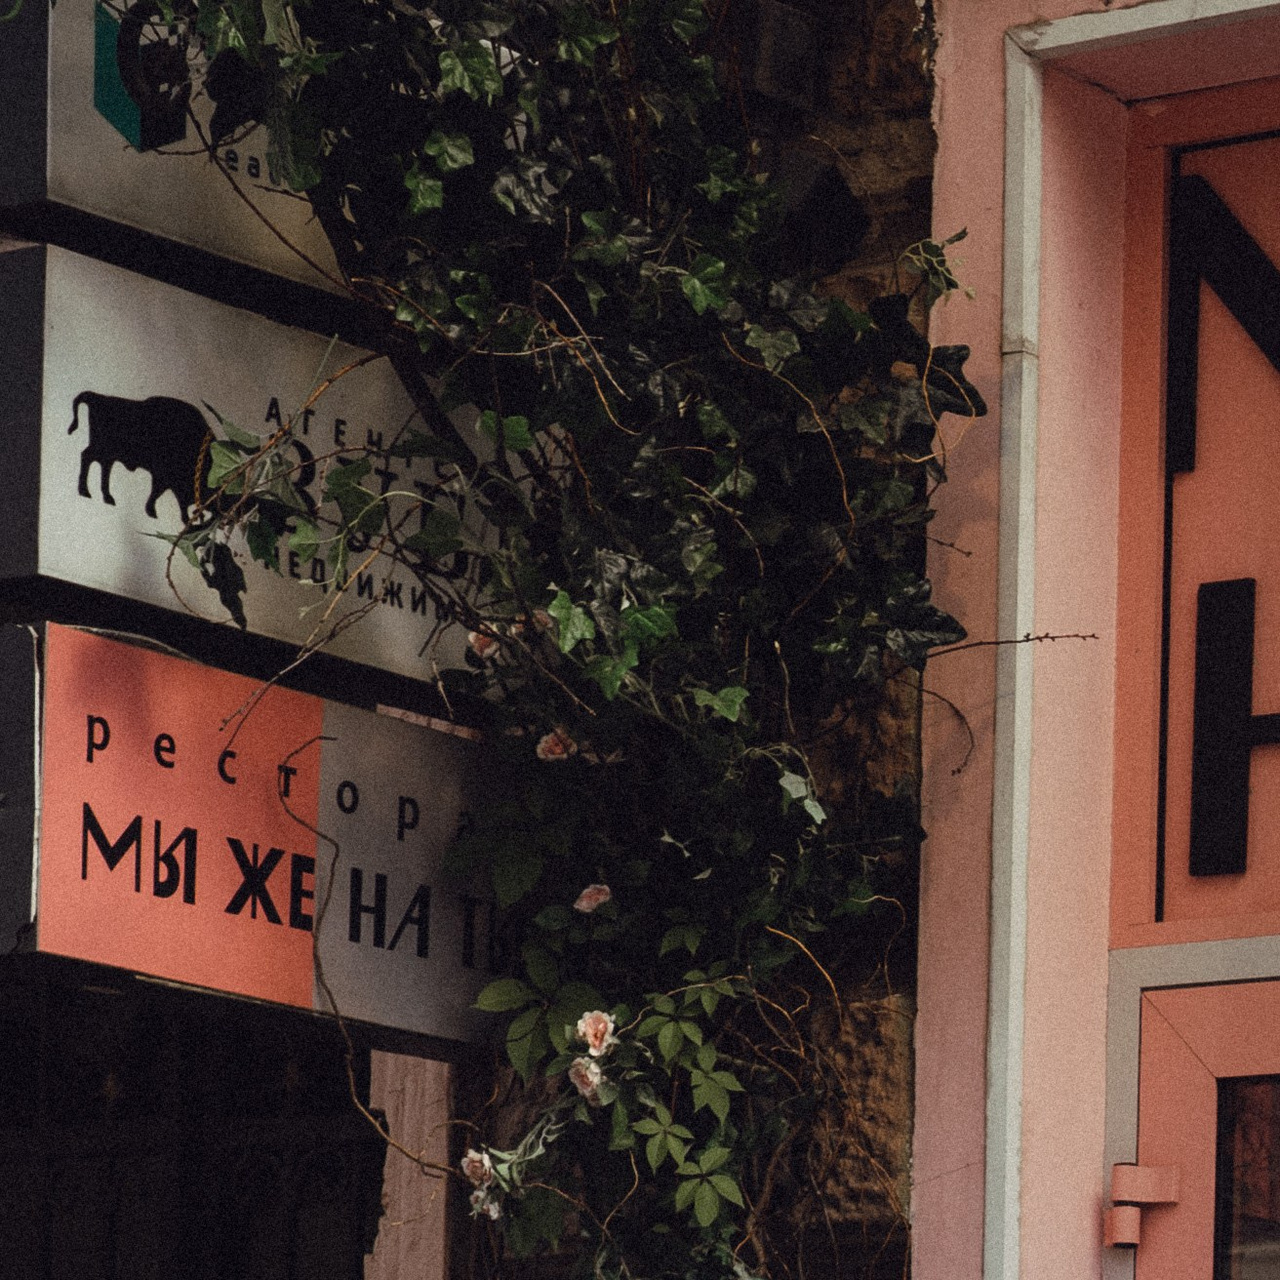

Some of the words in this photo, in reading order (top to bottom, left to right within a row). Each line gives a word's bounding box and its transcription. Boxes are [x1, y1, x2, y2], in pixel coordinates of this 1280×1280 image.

[81, 801, 198, 905] МЫ
[224, 836, 316, 933] ЖЕ
[348, 866, 431, 959] НА
